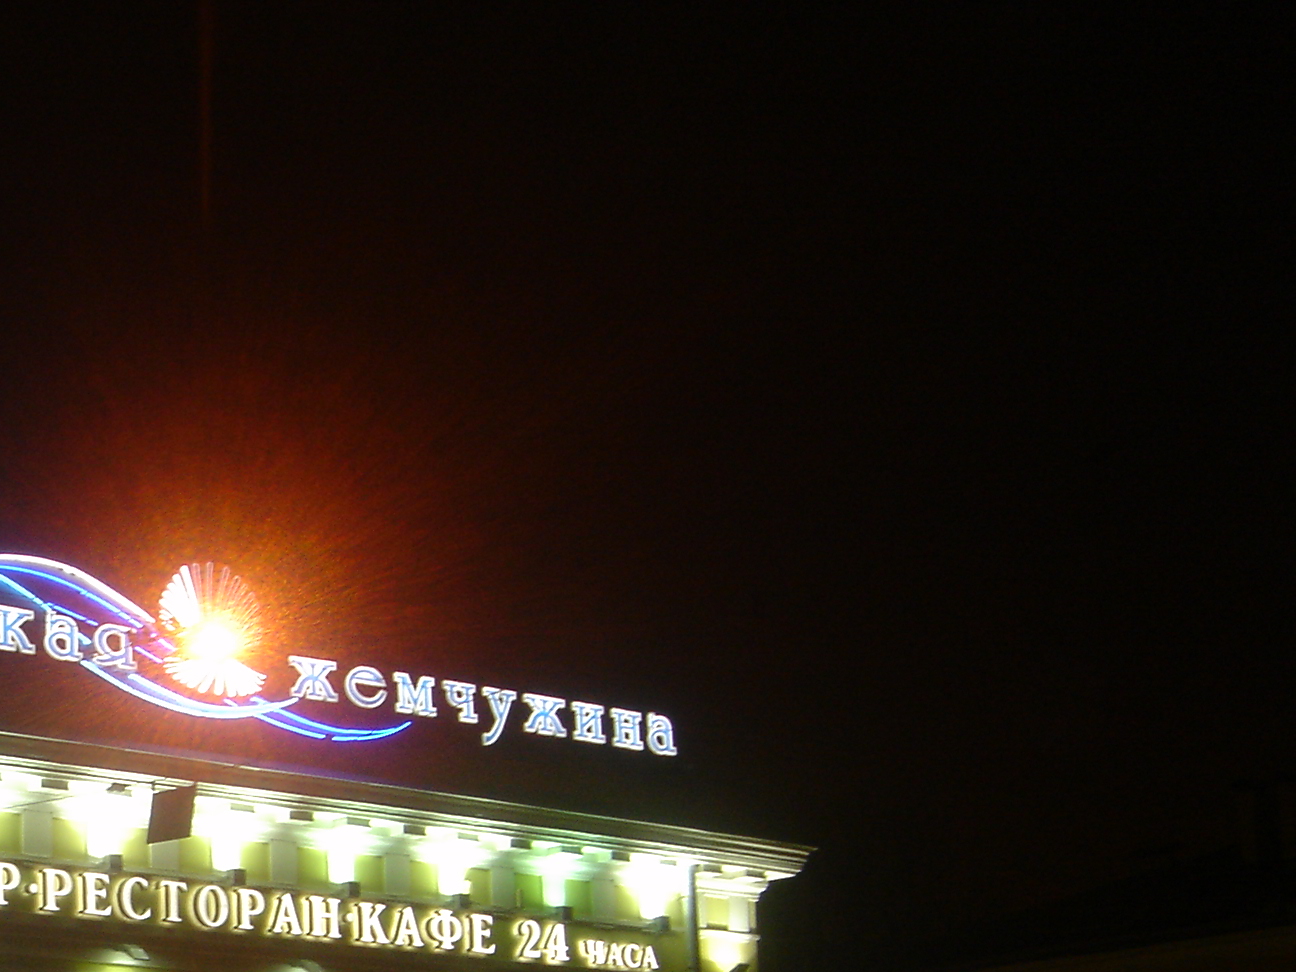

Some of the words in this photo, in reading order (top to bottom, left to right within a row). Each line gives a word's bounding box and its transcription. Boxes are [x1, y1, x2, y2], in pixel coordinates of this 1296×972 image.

[287, 655, 678, 757] жемчужина
[516, 919, 571, 963] 24
[581, 939, 660, 970] ЧАСА
